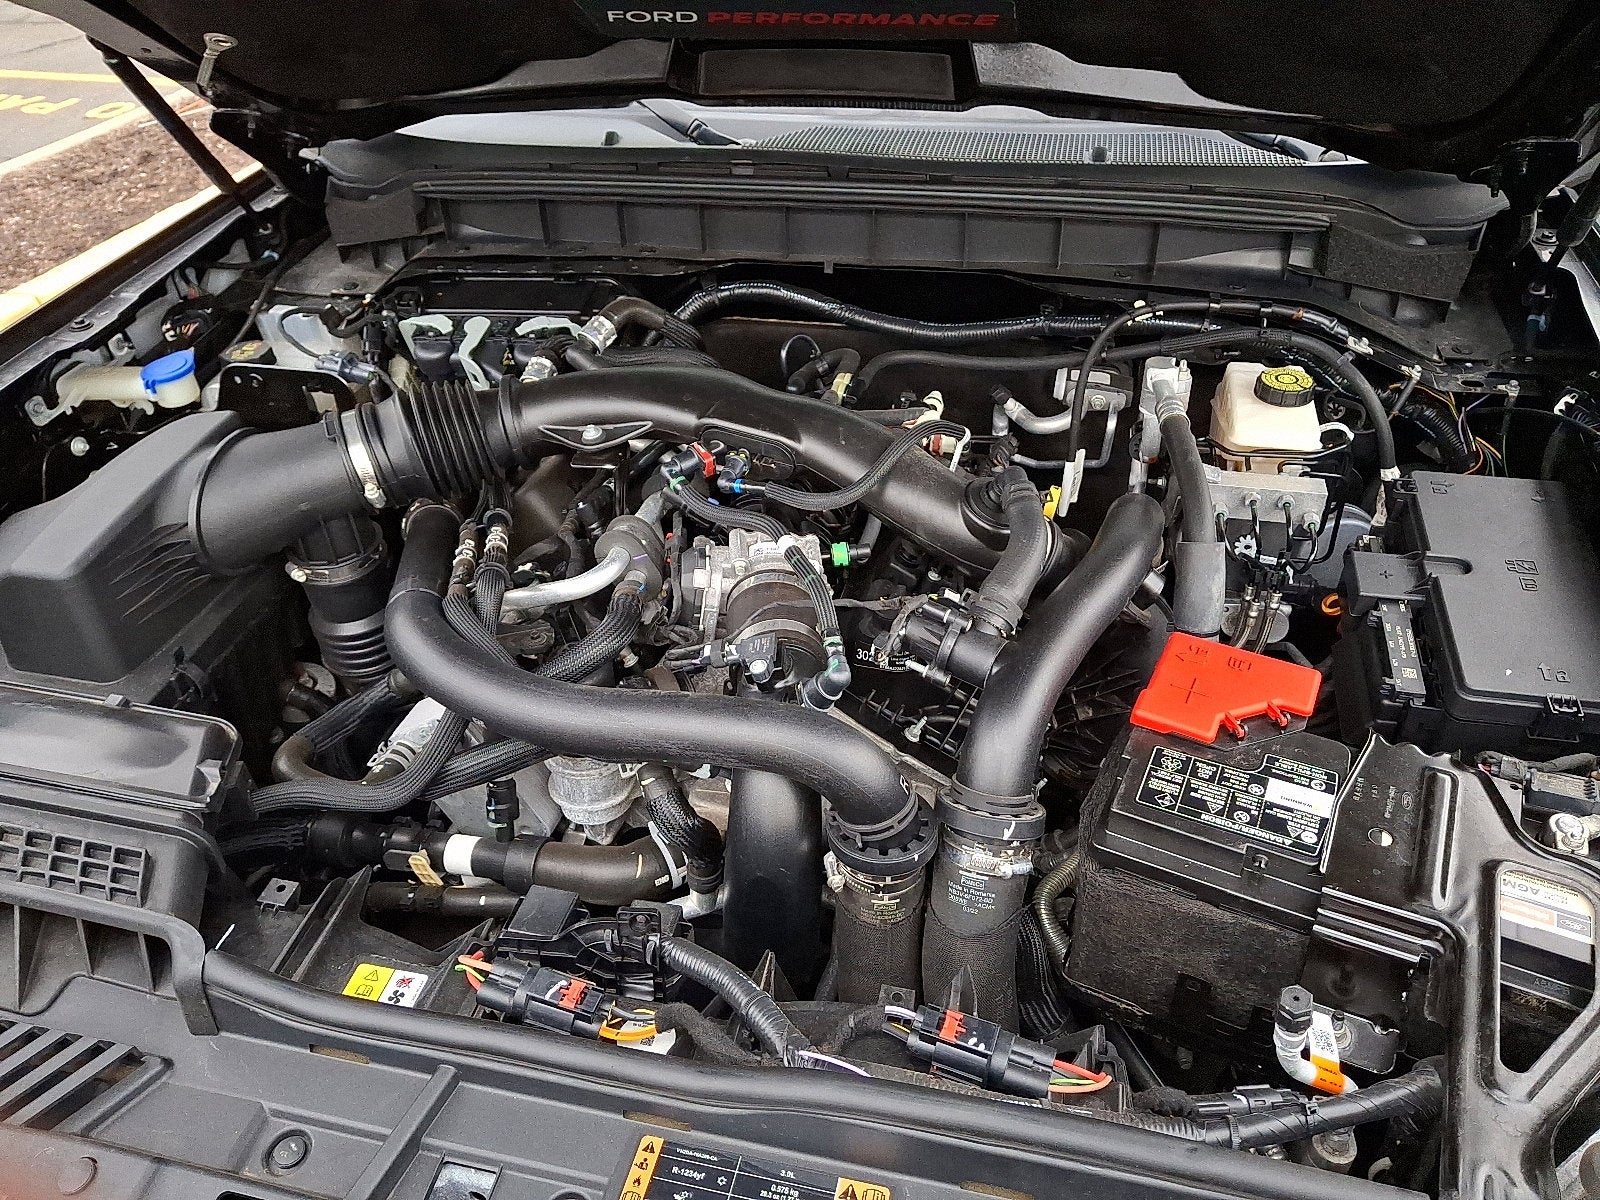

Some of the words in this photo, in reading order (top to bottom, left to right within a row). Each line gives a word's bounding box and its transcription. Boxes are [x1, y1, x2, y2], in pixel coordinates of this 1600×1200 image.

[607, 11, 698, 23] FORD
[707, 12, 999, 25] PERFORMANCE
[671, 1166, 706, 1181] R-1234yf
[780, 1169, 796, 1179] 3.0L
[790, 1187, 799, 1198] kg
